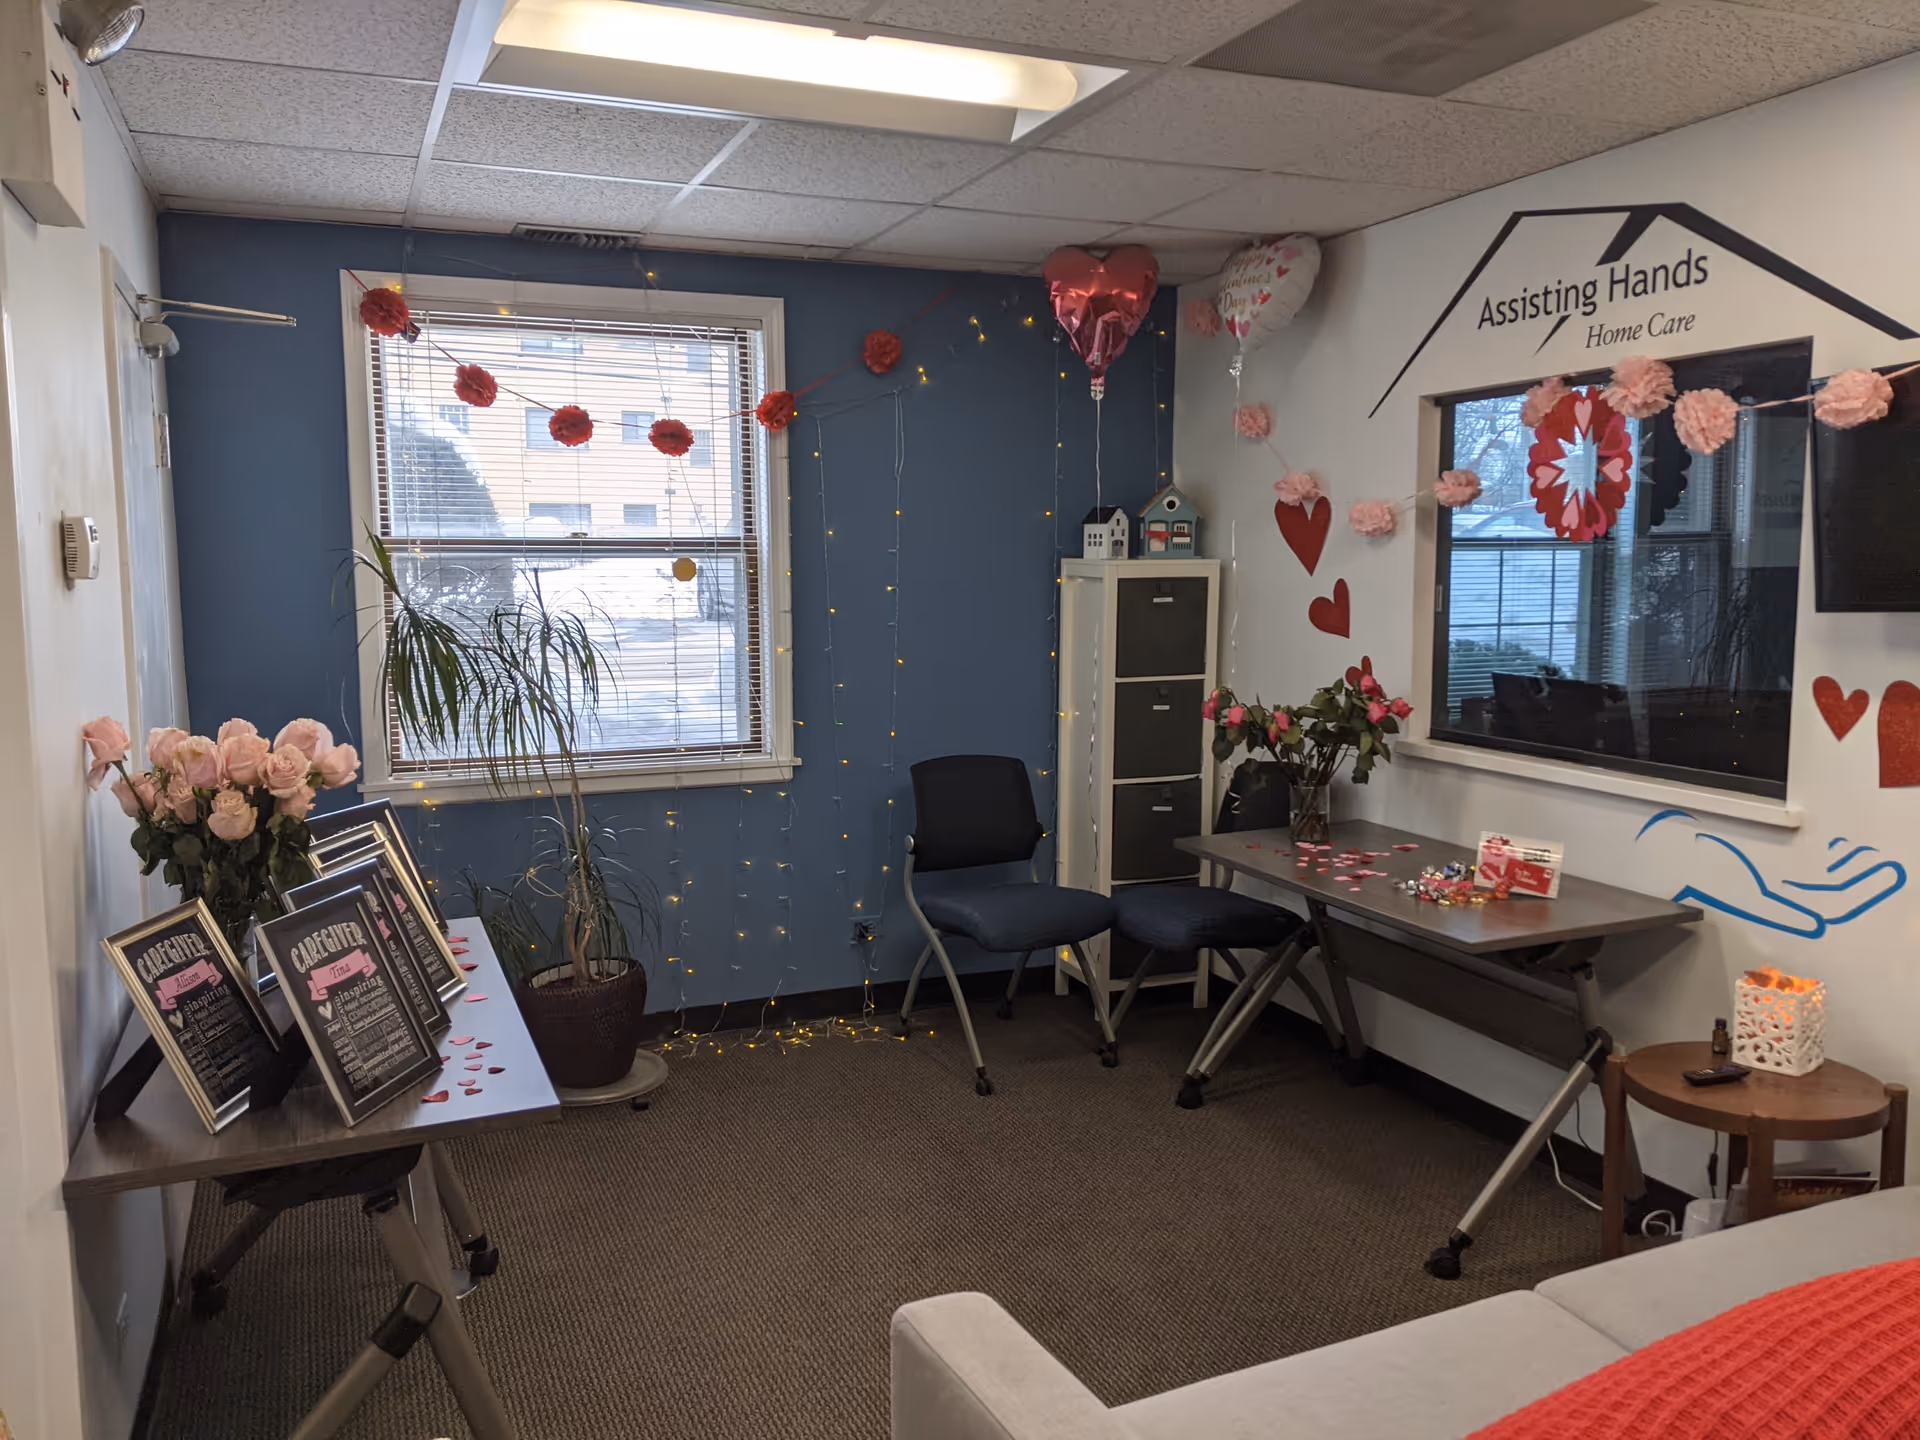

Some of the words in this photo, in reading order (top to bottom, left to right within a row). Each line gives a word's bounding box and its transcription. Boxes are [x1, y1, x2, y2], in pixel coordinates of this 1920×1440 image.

[1477, 279, 1598, 329] Assisting
[1608, 247, 1709, 302] Hands
[1584, 322, 1643, 349] Home
[1647, 312, 1696, 338] Care
[136, 932, 207, 984] CAREGIVER
[290, 921, 367, 974] CAREGIVER
[174, 970, 202, 993] Allison
[329, 964, 352, 980] Tina
[186, 984, 231, 1012] inspiring
[338, 975, 384, 1003] inspiring
